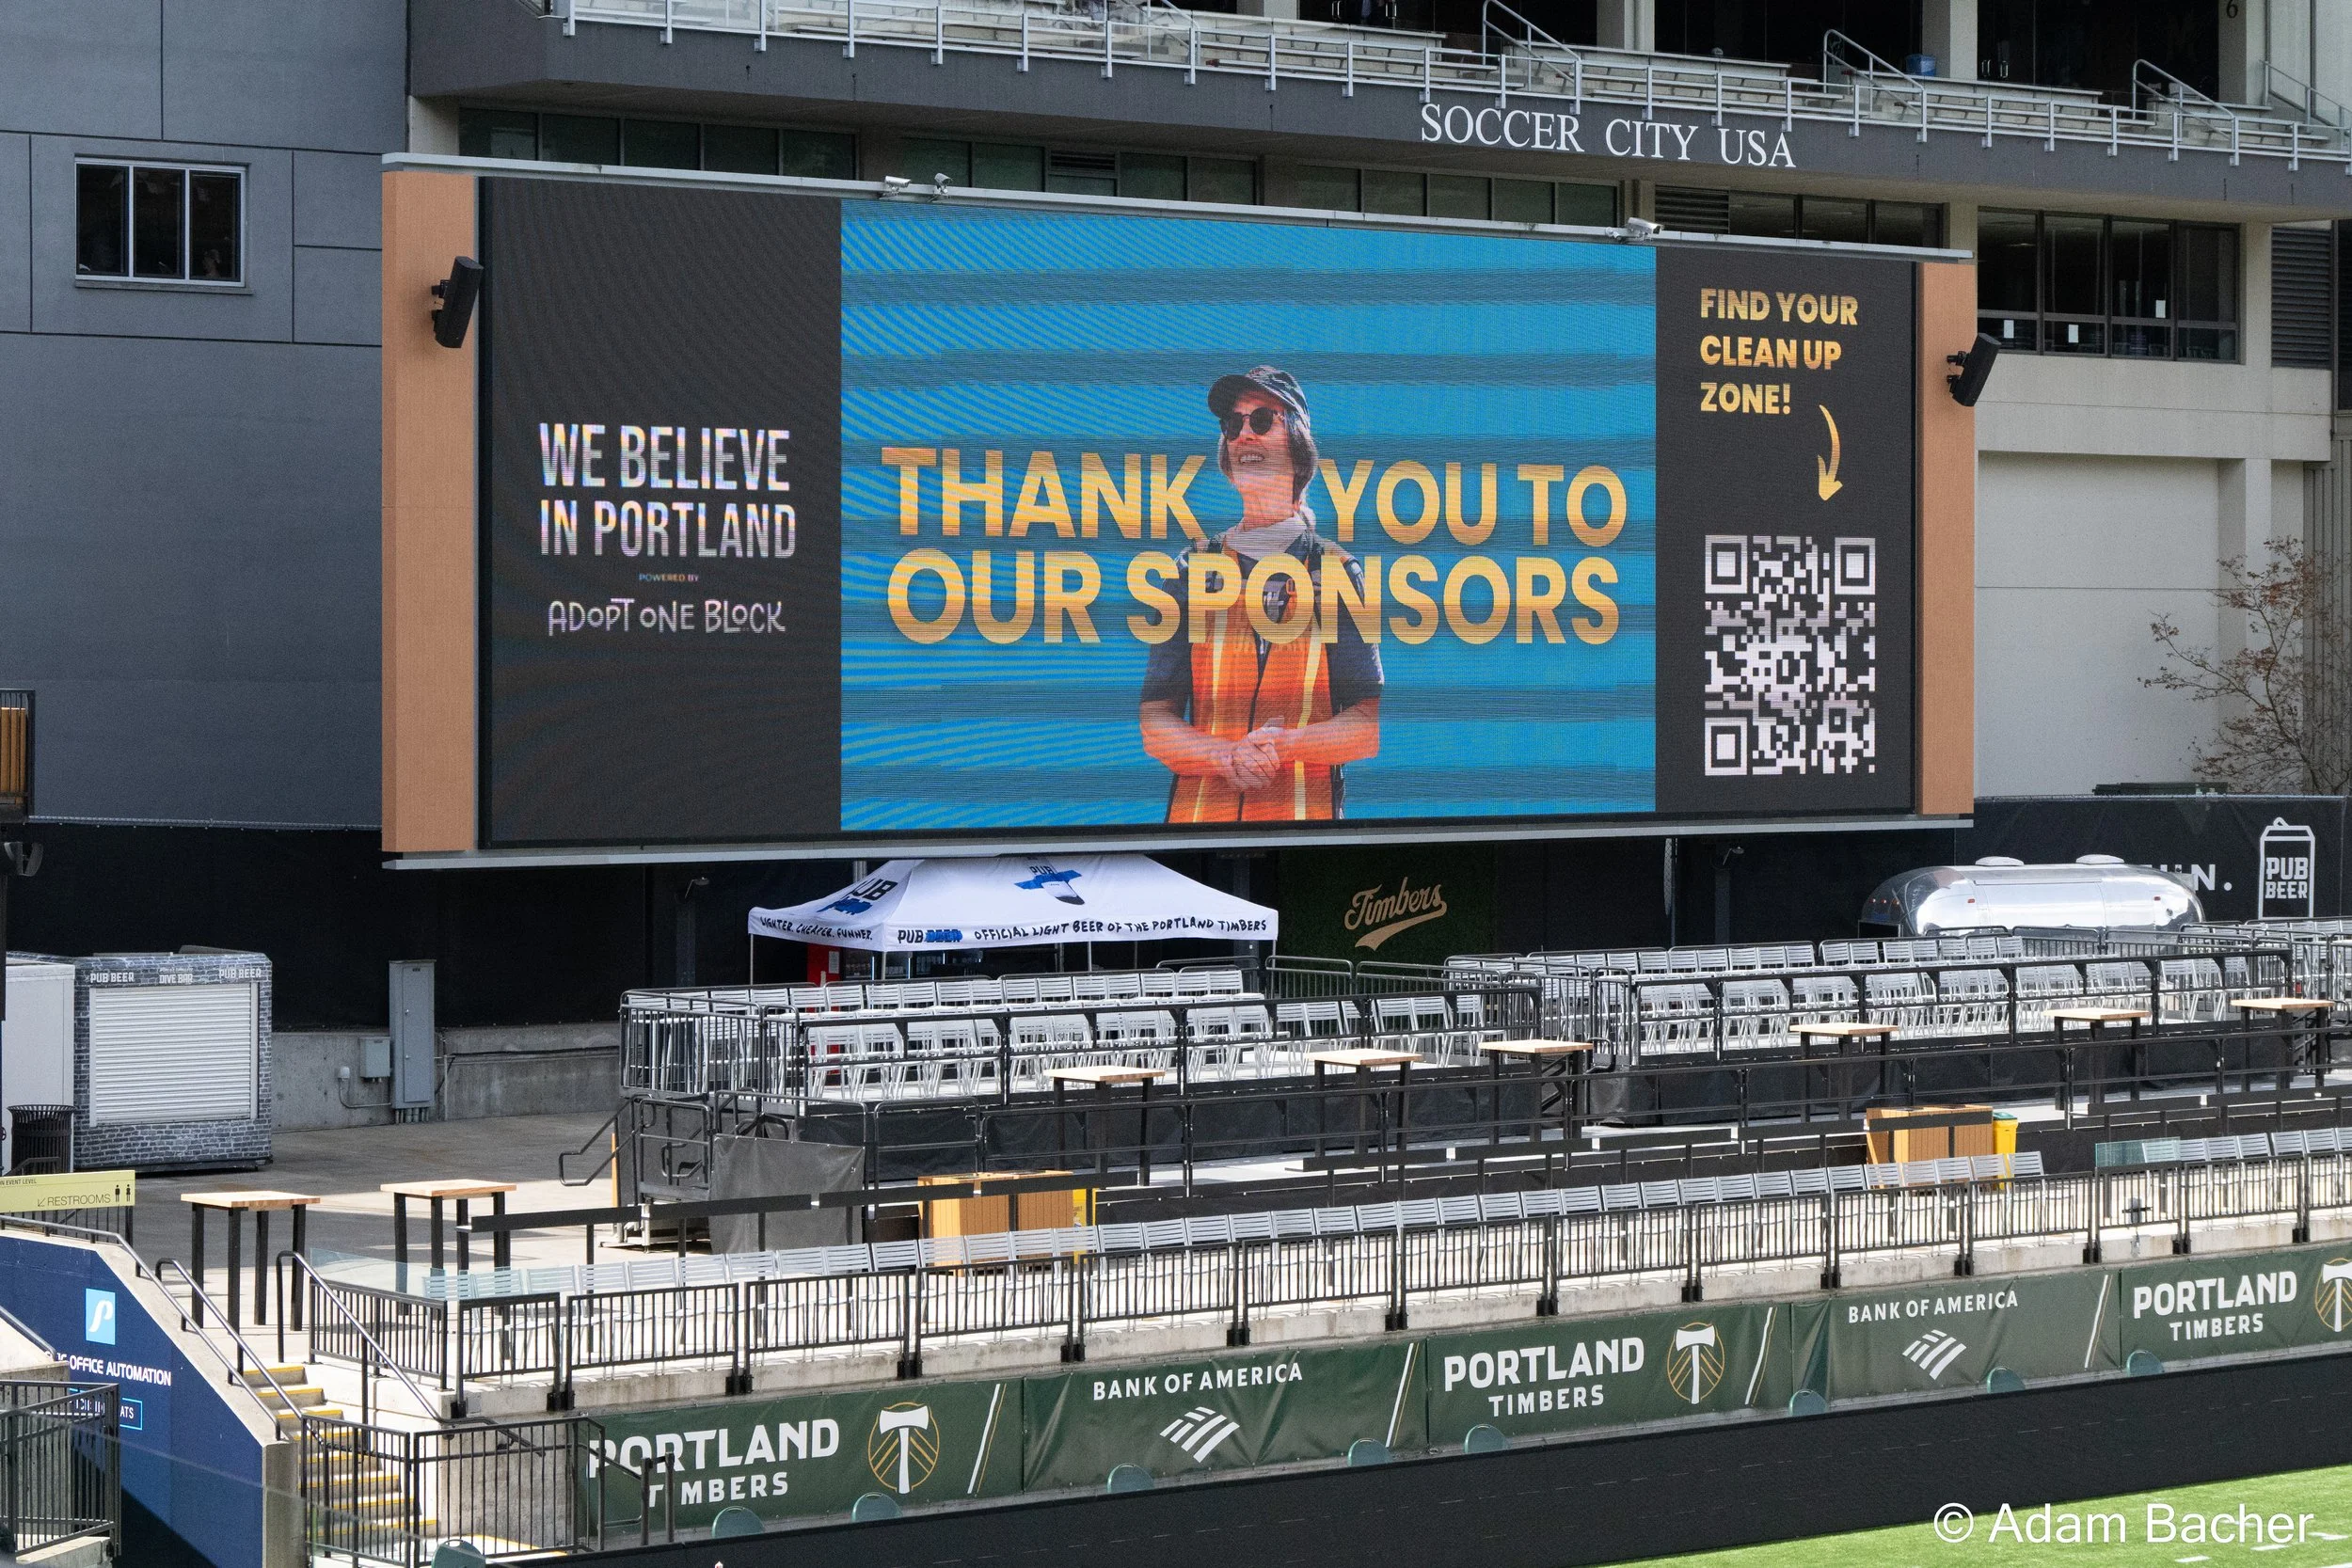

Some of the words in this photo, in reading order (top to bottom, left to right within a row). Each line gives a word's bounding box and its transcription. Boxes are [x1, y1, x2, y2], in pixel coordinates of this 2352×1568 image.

[1421, 103, 1584, 152] SOCCER
[1605, 119, 1698, 161] CITY
[1718, 128, 1796, 167] USA
[1700, 288, 1771, 321] FIND
[1776, 292, 1859, 325] YOUR
[1700, 335, 1797, 369] CLEAN
[1804, 340, 1842, 371] UP
[1700, 382, 1791, 415] ZONE!
[539, 422, 606, 487] WE
[620, 425, 790, 491] BELIEVE
[881, 446, 1207, 542] THANK
[1318, 458, 1498, 547] YOU
[1517, 464, 1629, 548] TO
[540, 499, 578, 556] IN
[594, 499, 797, 558] PORTLAND
[638, 573, 686, 582] POWERED
[687, 573, 699, 582] BY
[886, 548, 1103, 646] OUR
[1126, 550, 1621, 646] SPONSORS
[2265, 857, 2309, 880] PUB
[1344, 876, 1444, 931] Timbers
[2265, 880, 2308, 899] BEER
[759, 916, 794, 932] LIGHTER.
[898, 929, 924, 944] PUB
[974, 927, 1029, 941] OFFICIAL
[1032, 922, 1070, 937] LIGHT
[1073, 920, 1104, 933] BEER
[1107, 921, 1122, 933] OF
[1124, 922, 1150, 932] THE
[1152, 916, 1215, 931] PORTLAND
[1217, 919, 1266, 932] TIMBERS
[90, 973, 109, 984] PUB
[110, 972, 135, 983] BEER
[159, 974, 177, 984] DIVE
[177, 973, 193, 984] BAR
[219, 969, 236, 980] PUB
[238, 968, 262, 978] BEER
[47, 1194, 111, 1207] RESTROOMS
[1849, 1301, 1900, 1323] BANK
[1906, 1299, 1930, 1318] OF
[1933, 1291, 2018, 1316] AMERICA
[2134, 1271, 2297, 1319] PORTLAND
[2169, 1313, 2264, 1341] TIMBERS
[69, 1354, 104, 1375] OFFICE
[105, 1361, 172, 1386] AUTOMATION
[1444, 1337, 1645, 1392] PORTLAND
[1093, 1376, 1158, 1401] BANK
[1164, 1372, 1194, 1394] OF
[1199, 1362, 1303, 1391] AMERICA
[1488, 1384, 1604, 1418] TIMBERS
[587, 1418, 840, 1479] PORTLAND
[648, 1471, 788, 1508] TMBERS
